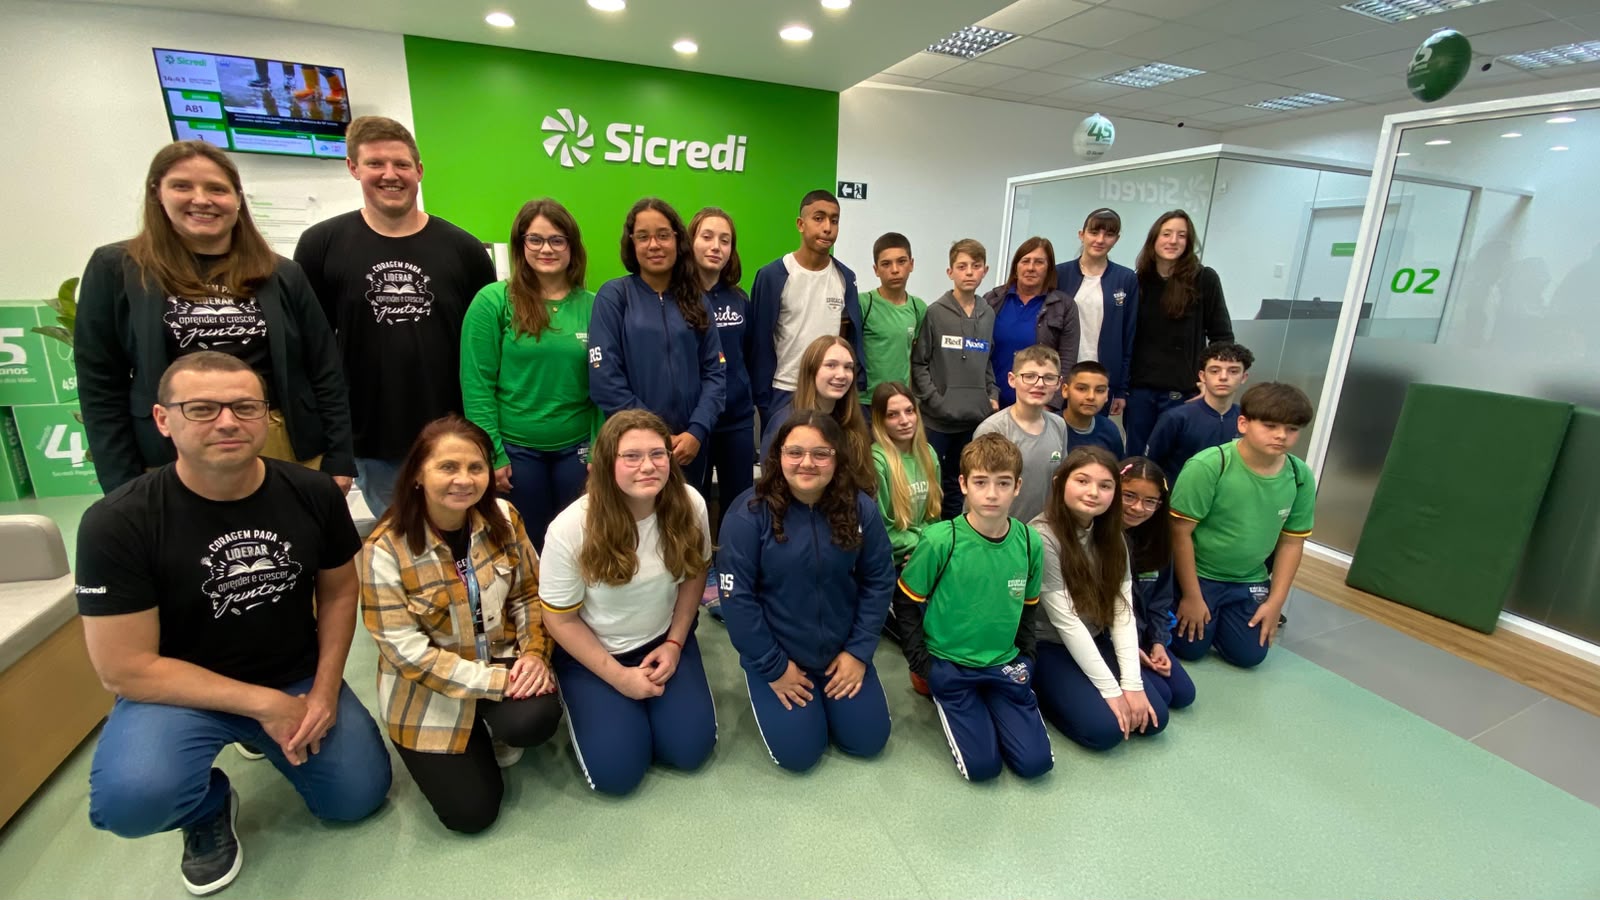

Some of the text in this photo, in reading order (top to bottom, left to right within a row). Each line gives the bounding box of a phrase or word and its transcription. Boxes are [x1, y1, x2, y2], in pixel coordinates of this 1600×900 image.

[176, 57, 207, 66] Sicredi
[1087, 122, 1112, 142] 45
[604, 122, 747, 172] Sicredi
[372, 261, 422, 274] CORAGEM PARA
[383, 273, 413, 282] LIDERAR
[1390, 268, 1441, 294] 02
[178, 315, 217, 325] aprender
[226, 315, 256, 323] crescer
[376, 303, 426, 323] juntos
[180, 324, 260, 348] juntos
[944, 337, 962, 346] Red
[589, 346, 602, 364] RS
[208, 529, 278, 552] CORAGEM PARA
[225, 544, 269, 561] LIDERAR
[80, 586, 106, 594] Sicredi
[218, 570, 289, 592] aprender e crescer
[719, 573, 734, 591] RS
[214, 582, 289, 619] juntos
